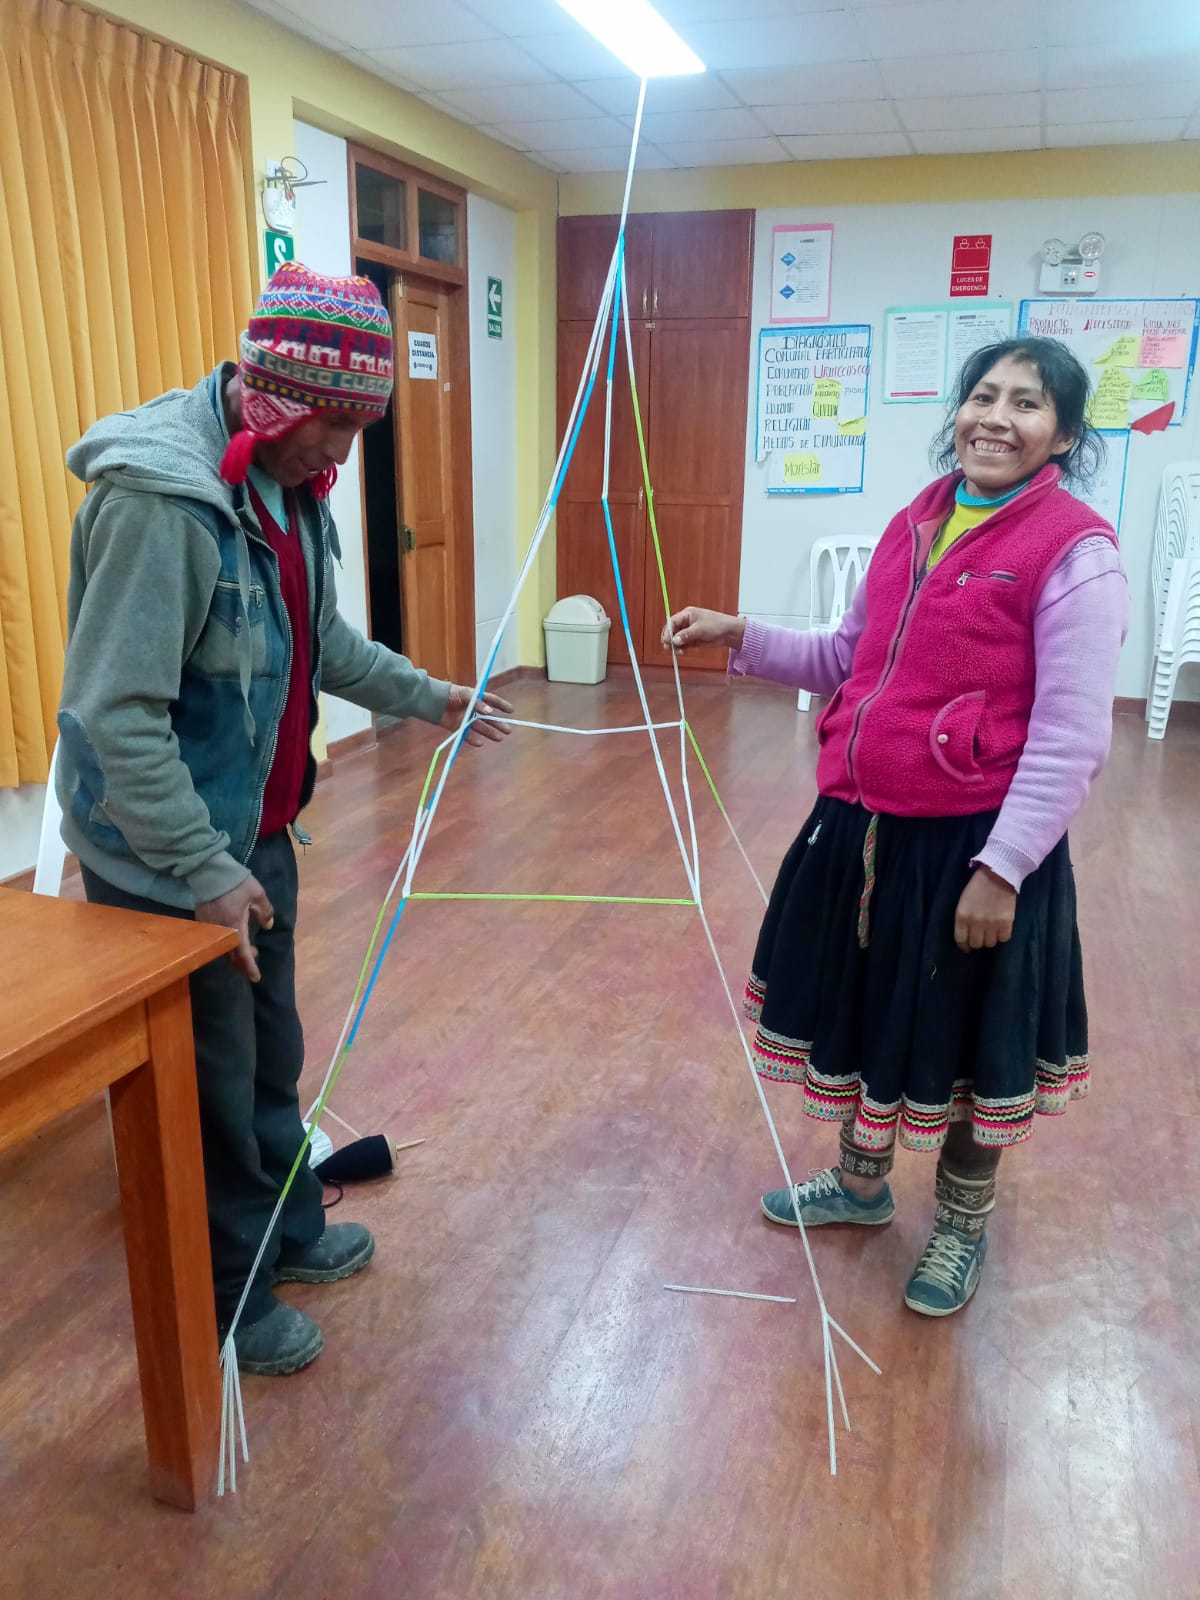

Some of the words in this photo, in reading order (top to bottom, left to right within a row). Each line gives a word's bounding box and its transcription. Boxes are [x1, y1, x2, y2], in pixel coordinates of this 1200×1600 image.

[414, 339, 431, 348] GUARDE
[412, 349, 435, 358] DISTANCIA
[265, 355, 332, 386] CUSCO
[341, 374, 392, 393] CUSCO
